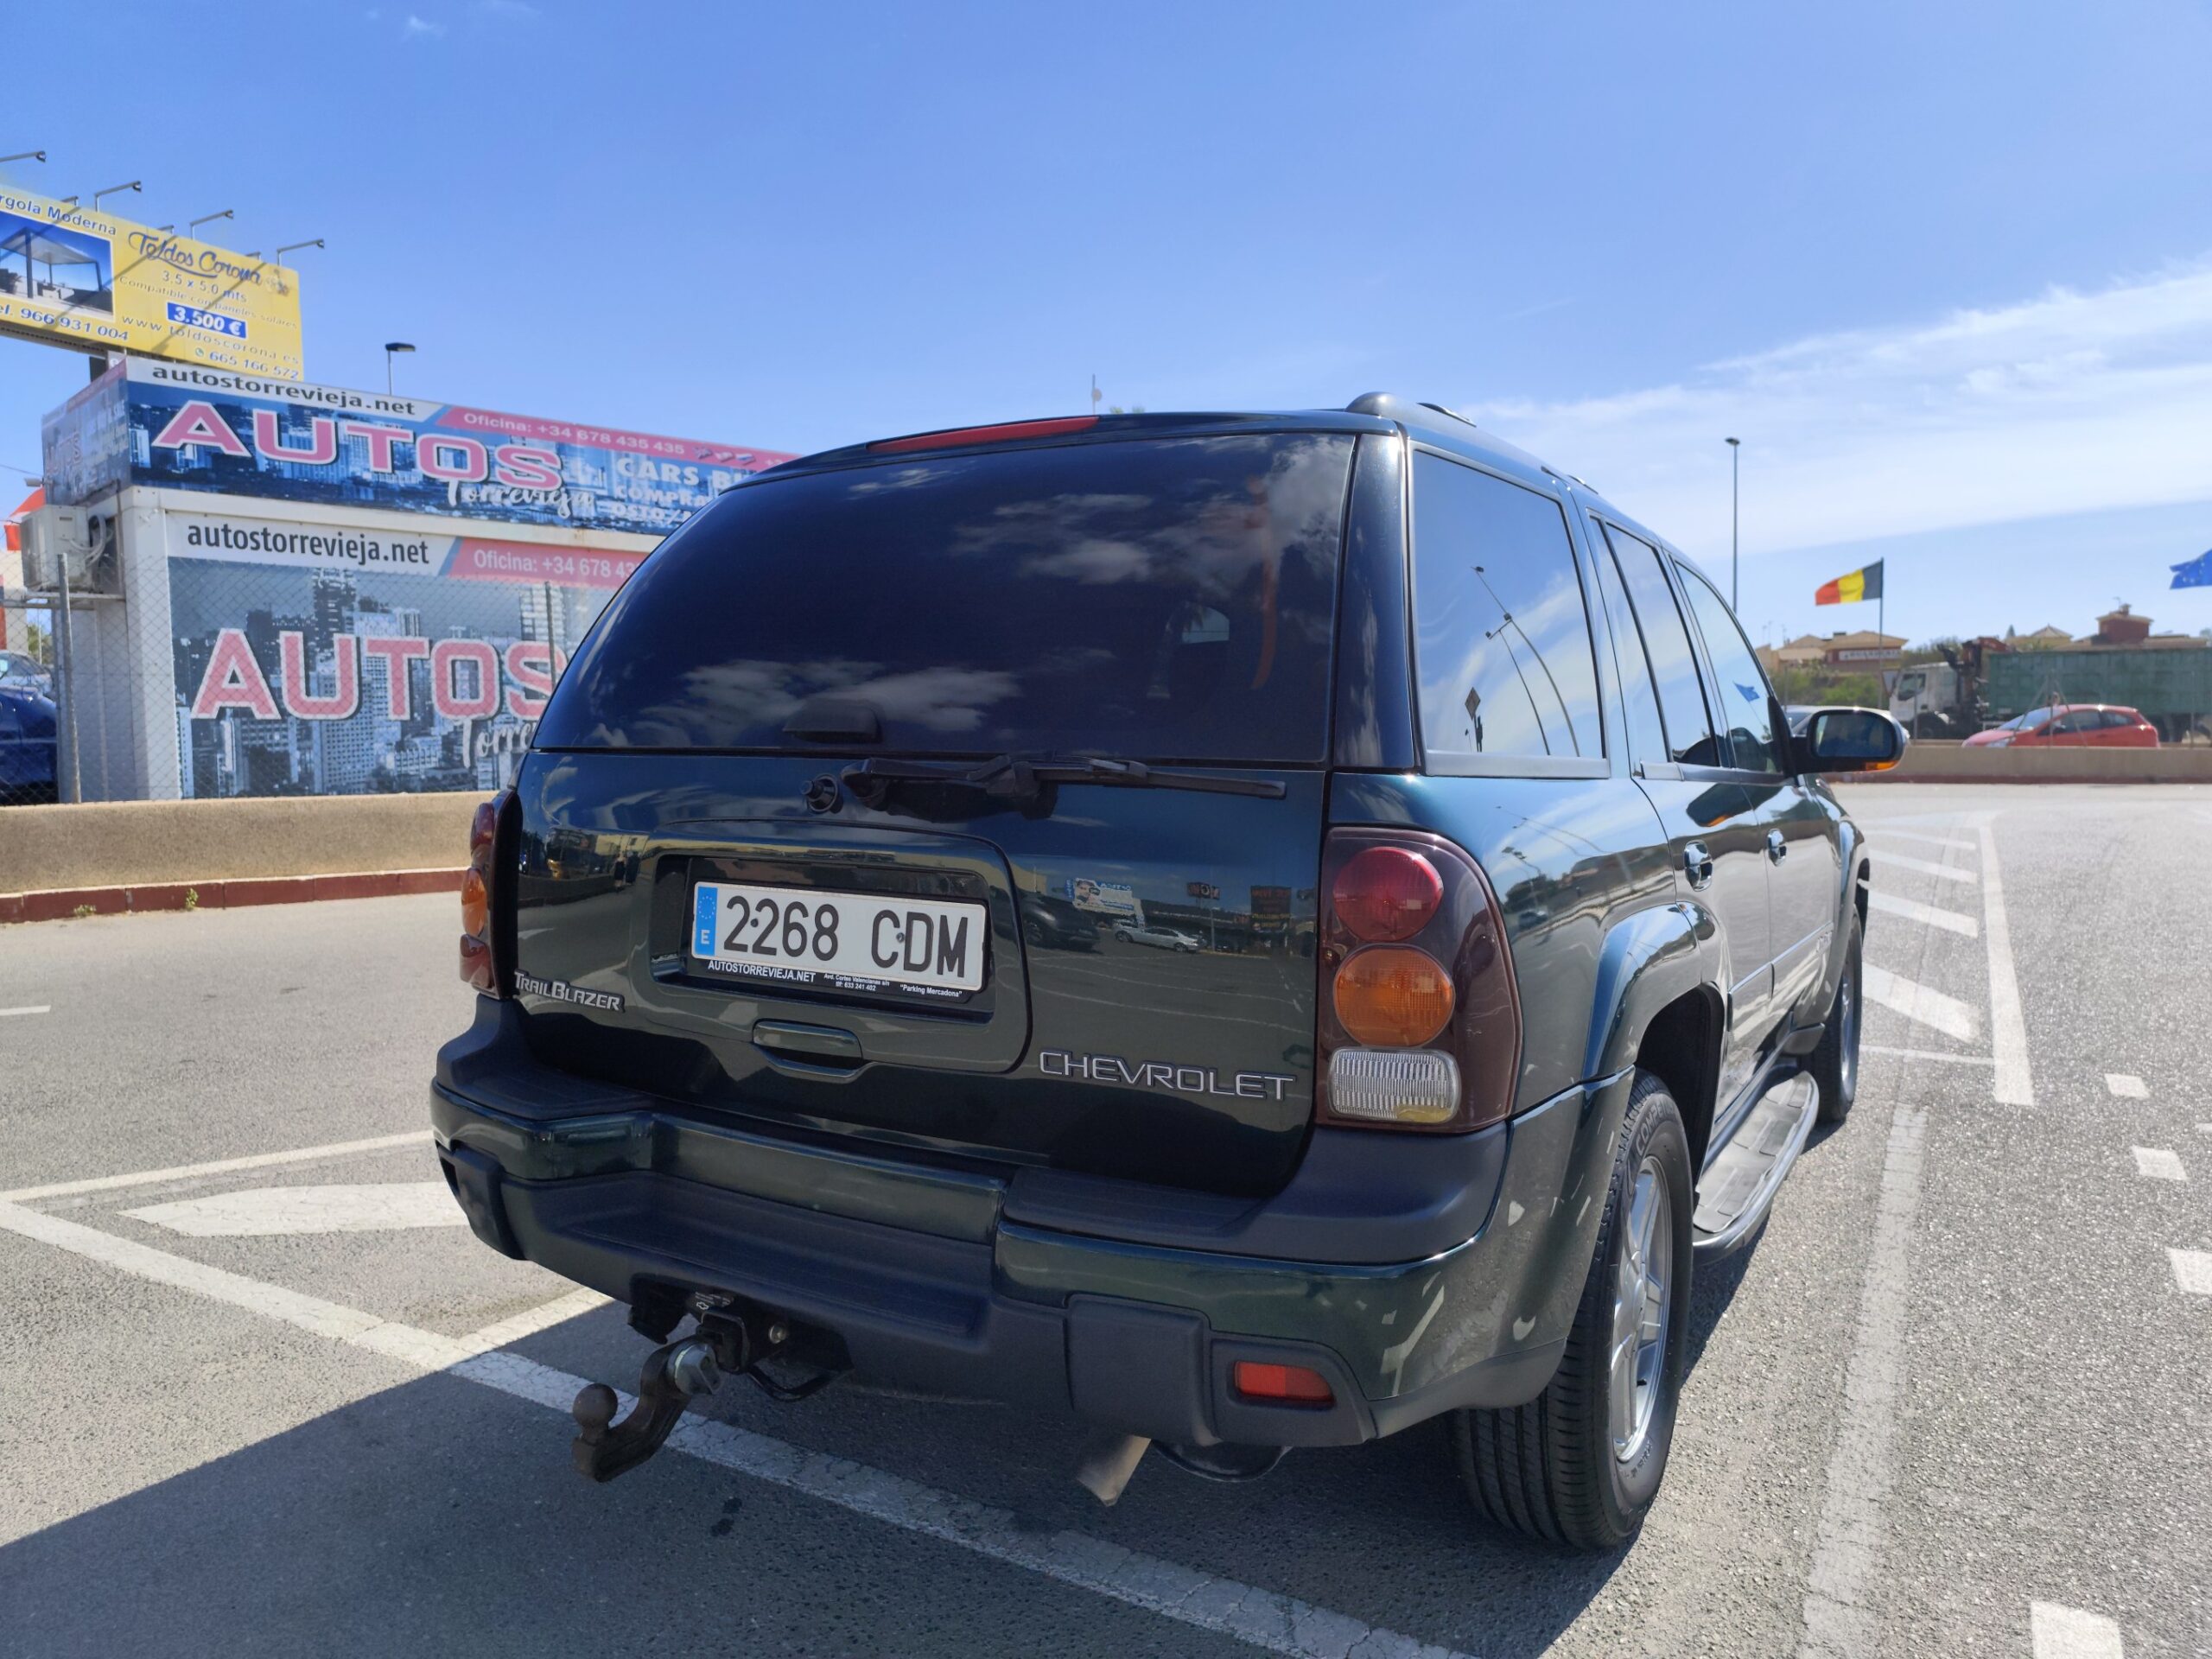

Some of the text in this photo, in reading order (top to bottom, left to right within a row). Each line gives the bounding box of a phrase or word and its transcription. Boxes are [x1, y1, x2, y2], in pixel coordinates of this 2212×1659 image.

[48, 206, 117, 236] Moderna
[128, 232, 263, 286] Toldos Corona
[119, 275, 187, 299] Compatible
[214, 301, 257, 320] paneles
[260, 314, 298, 330] solares
[173, 306, 242, 335] 3.500 €
[21, 308, 54, 325] 966
[60, 316, 91, 333] 931
[97, 326, 129, 340] 004
[209, 352, 300, 379] 665 166 572
[152, 366, 416, 416] autostorrevieja.net
[150, 399, 564, 492] AUTOS
[463, 412, 685, 454] Oficina: +34 678 435 435
[616, 457, 701, 486] CARS
[445, 479, 595, 518] Torrevieja
[187, 523, 430, 566] autostorrevieja.net
[474, 549, 640, 579] Oficina: +34 678 43
[190, 627, 568, 721] AUTOS
[700, 929, 710, 944] E
[723, 895, 969, 978] 2268 CDM
[708, 960, 816, 983] AUTOSTORREVIEJA.NET
[1039, 1050, 1294, 1101] CHEVROLET
